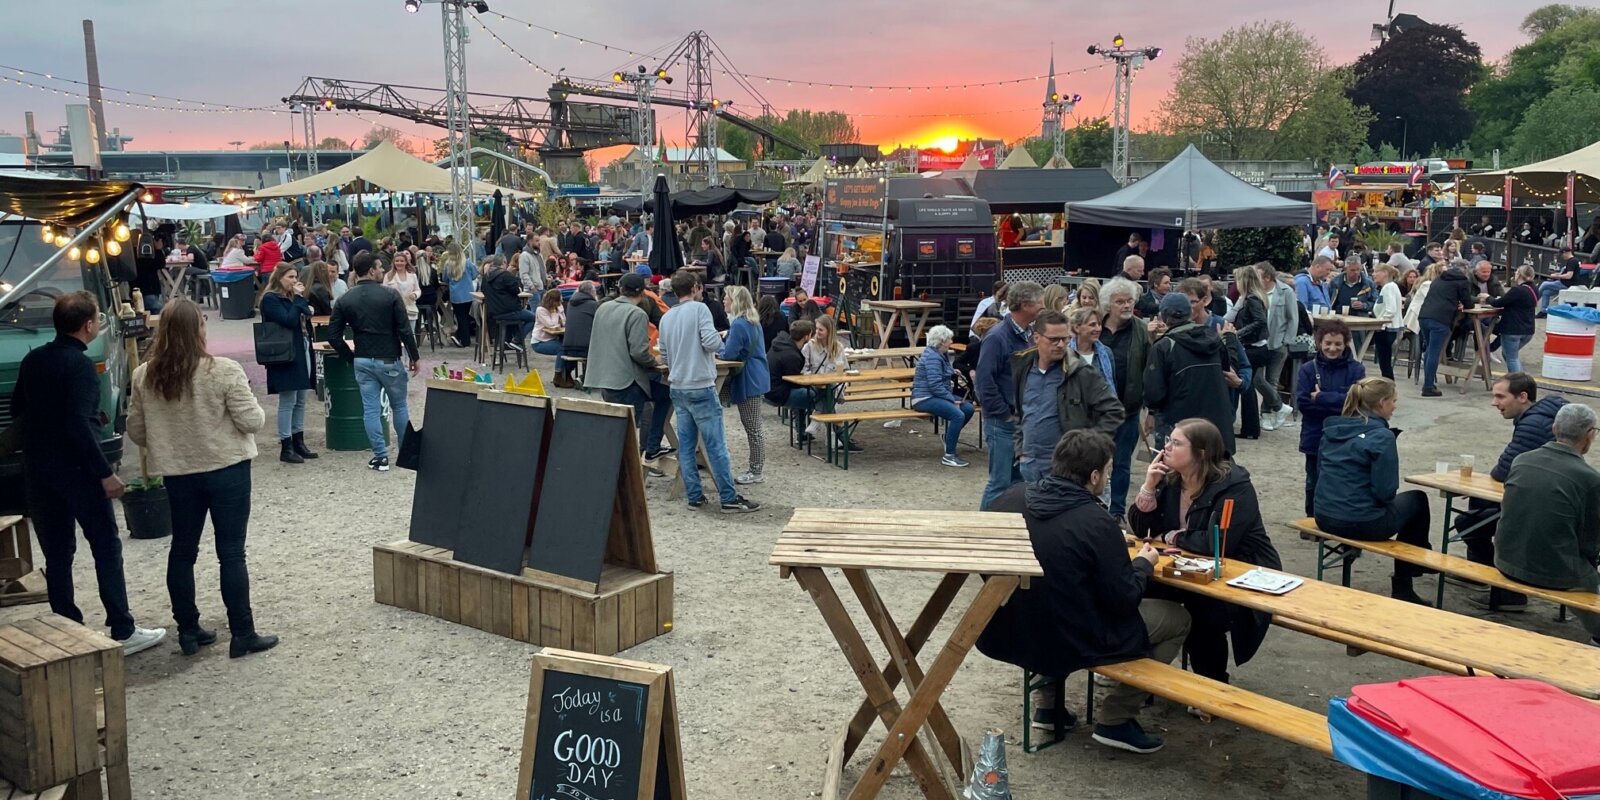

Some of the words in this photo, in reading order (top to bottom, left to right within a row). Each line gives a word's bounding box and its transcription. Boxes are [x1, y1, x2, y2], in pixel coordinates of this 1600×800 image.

[552, 686, 601, 715] Today
[600, 708, 610, 722] is
[613, 708, 622, 722] a
[553, 729, 620, 768] GOOD
[566, 762, 614, 789] DAY
